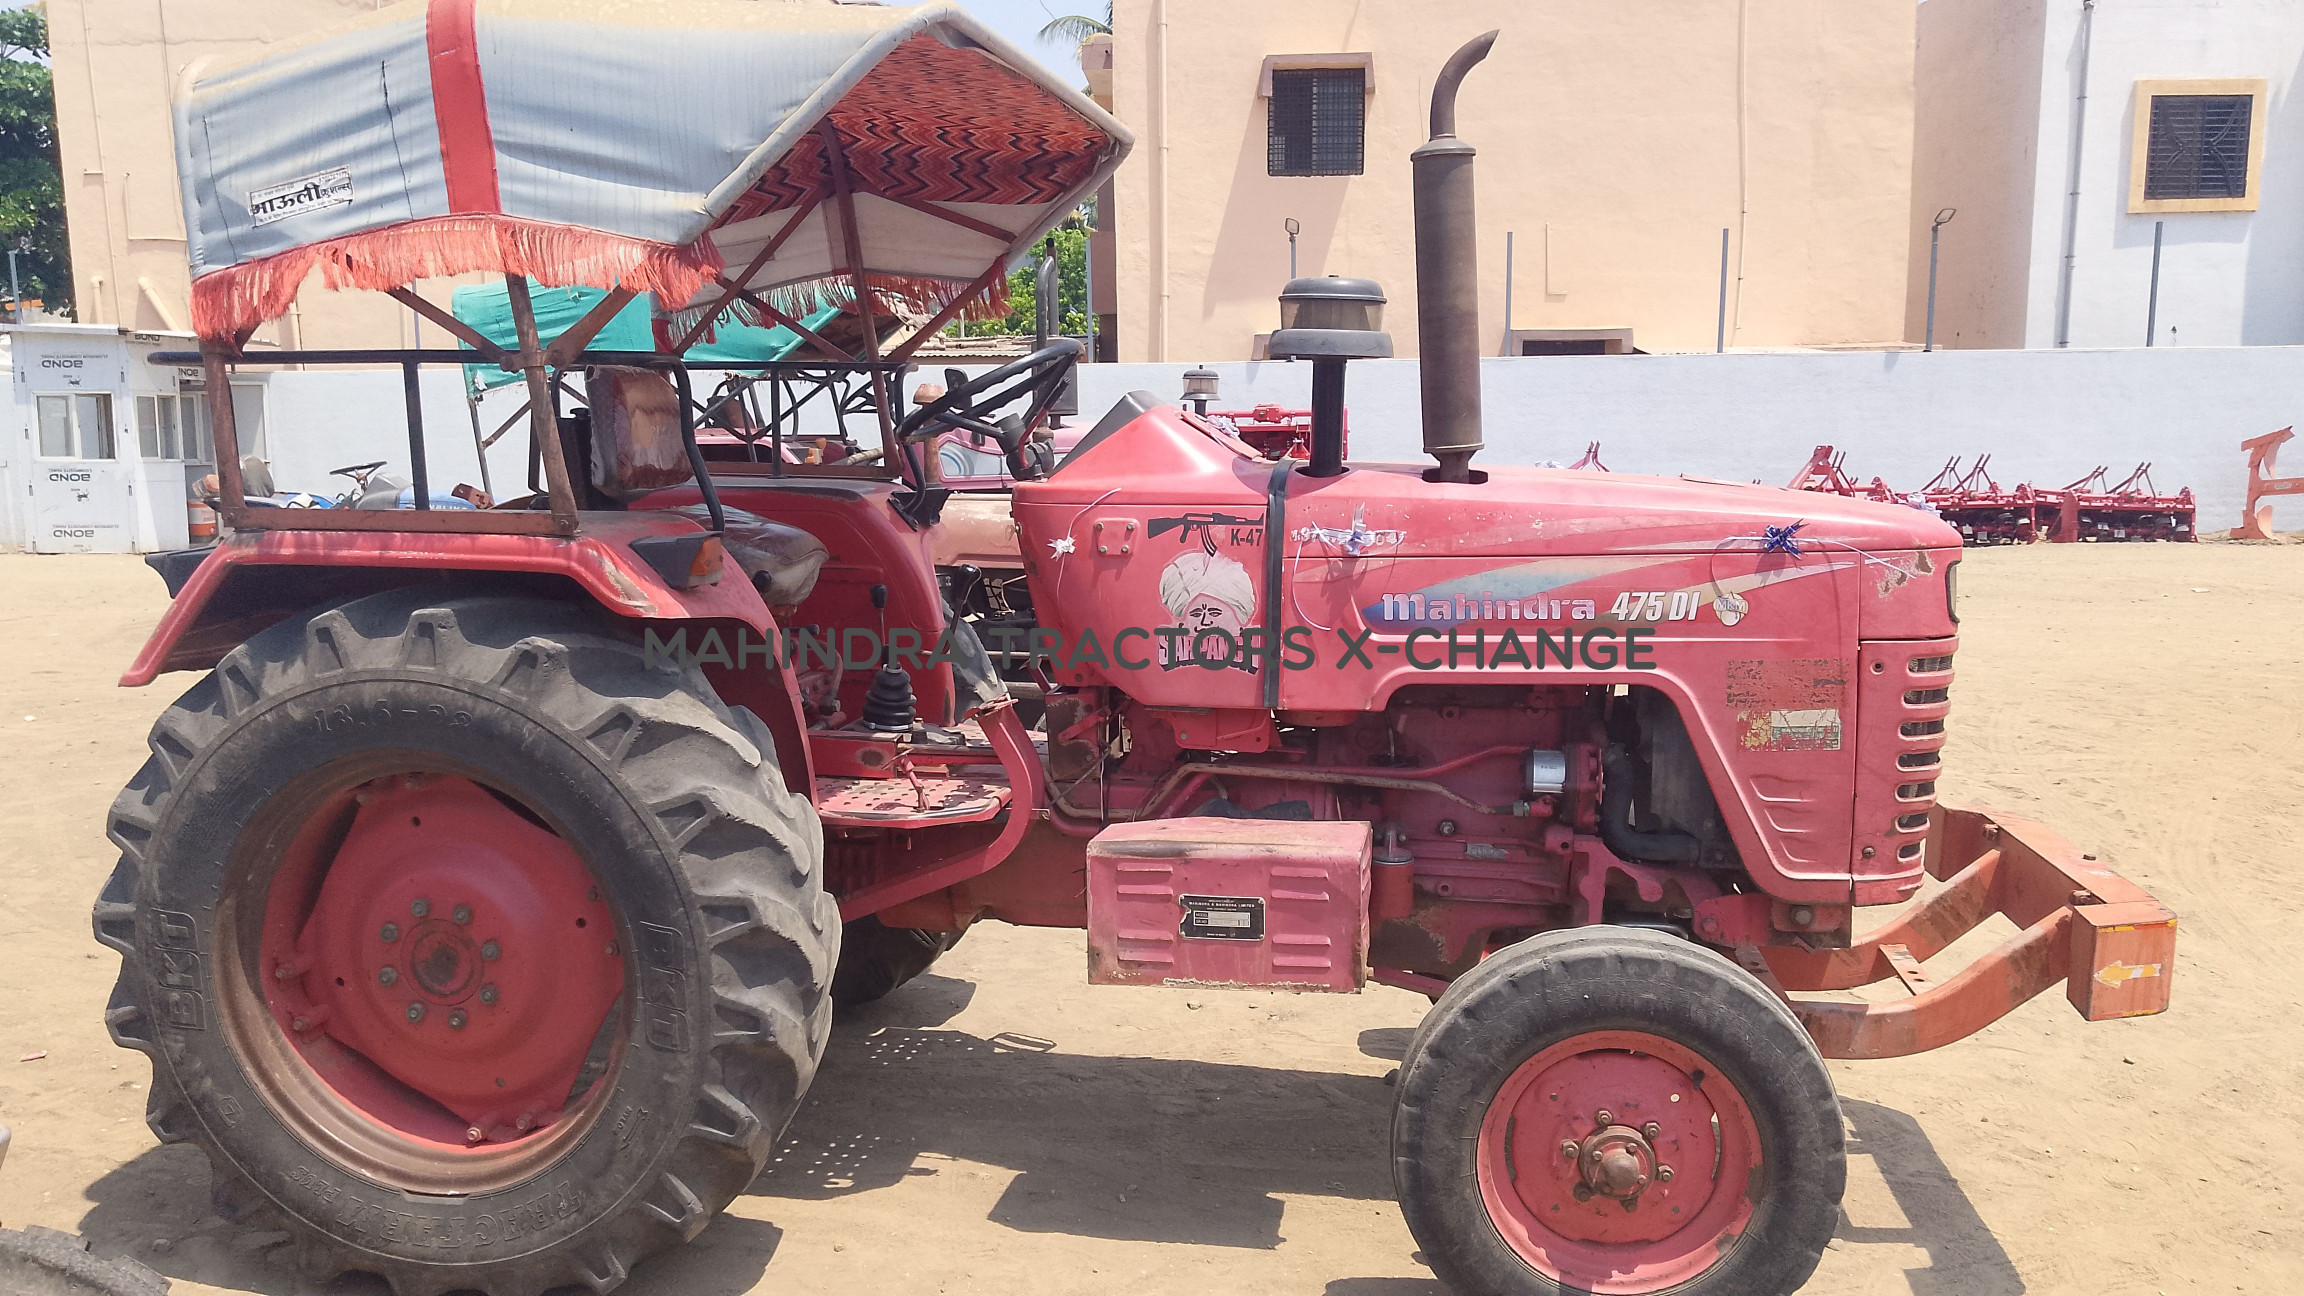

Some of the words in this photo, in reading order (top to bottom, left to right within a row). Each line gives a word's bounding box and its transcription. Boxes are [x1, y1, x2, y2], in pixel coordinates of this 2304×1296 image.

[42, 360, 83, 368] BOND
[49, 473, 91, 482] BOND
[53, 529, 95, 538] BOND
[1231, 529, 1263, 546] K-47
[1382, 591, 1596, 621] Mahindra
[1610, 591, 1667, 622] 475
[1667, 591, 1700, 622] DI
